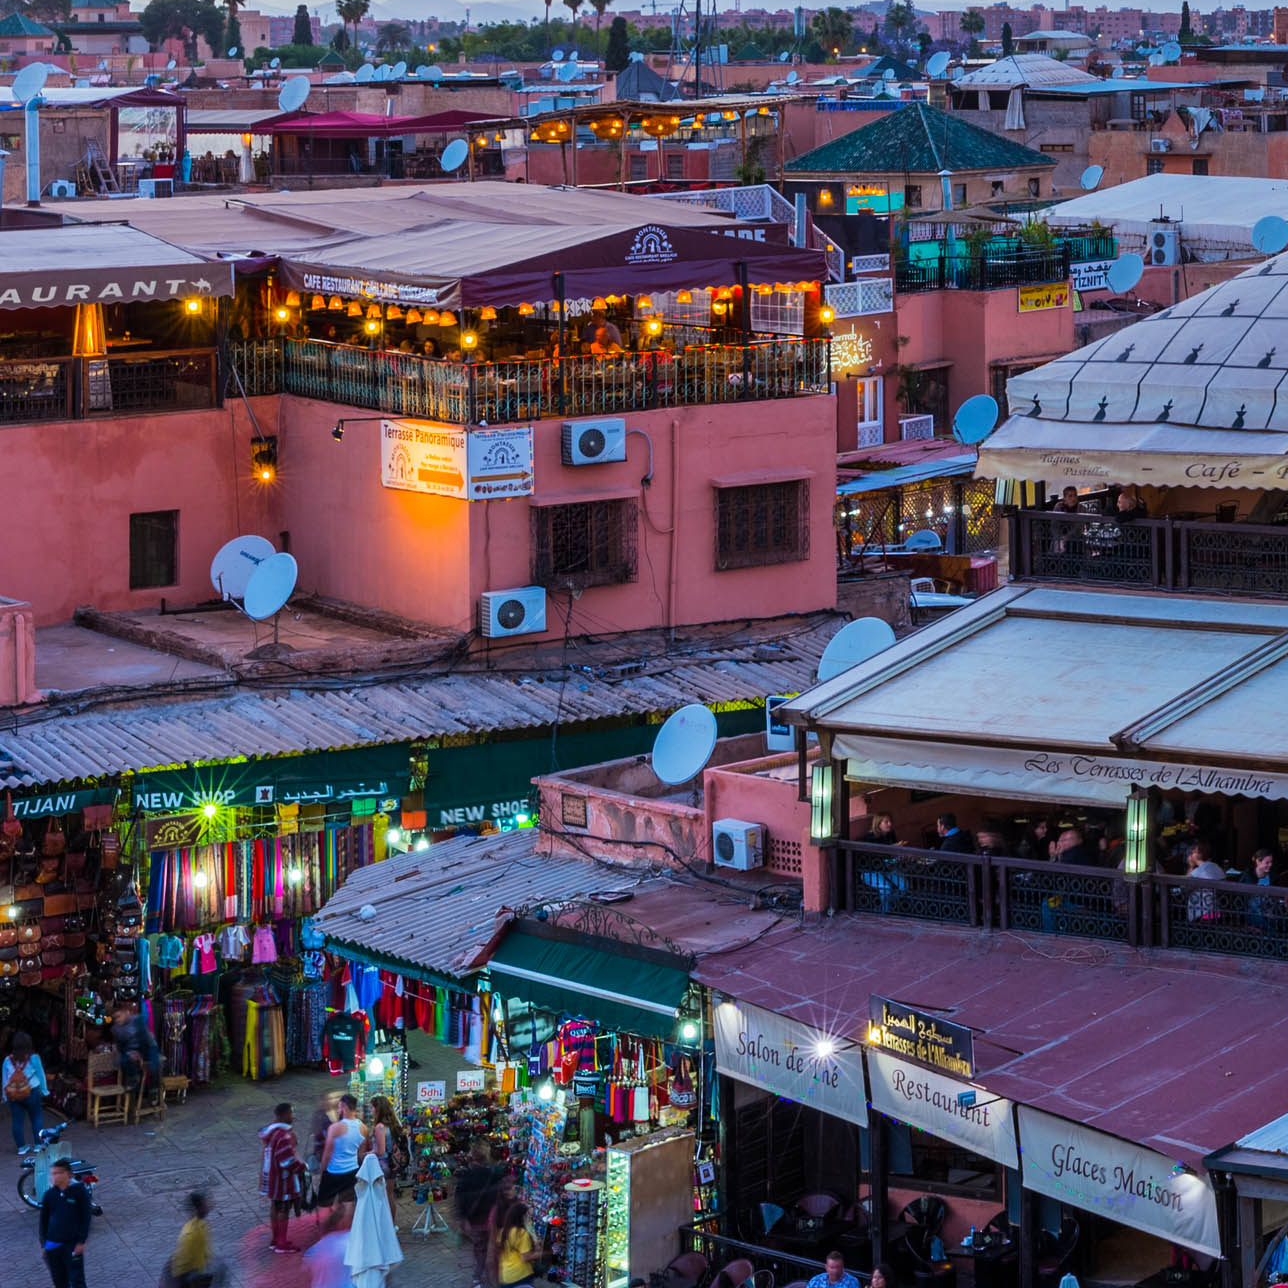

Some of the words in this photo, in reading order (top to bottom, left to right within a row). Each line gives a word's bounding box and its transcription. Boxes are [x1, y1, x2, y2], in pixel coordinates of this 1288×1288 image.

[304, 273, 321, 289] CAFE
[1073, 275, 1103, 289] TIZNIT
[384, 424, 413, 442] Terrasse
[415, 429, 465, 452] Panoramique
[1040, 454, 1081, 464] Tagines
[1185, 461, 1240, 482] Café
[1024, 753, 1063, 774] Les
[1069, 755, 1147, 781] Terrasses
[1151, 766, 1171, 782] de
[1175, 767, 1275, 793] l'Alhambra
[13, 795, 77, 817] TIJANI
[137, 792, 184, 808] NEW
[193, 790, 236, 808] SHOP
[440, 804, 484, 825] NEW
[736, 1031, 781, 1067] Salon
[786, 1047, 804, 1073] de
[881, 1024, 915, 1057] Terrasses
[916, 1039, 928, 1062] de
[1051, 1143, 1107, 1184] Glaces
[1113, 1166, 1184, 1212] Maison
